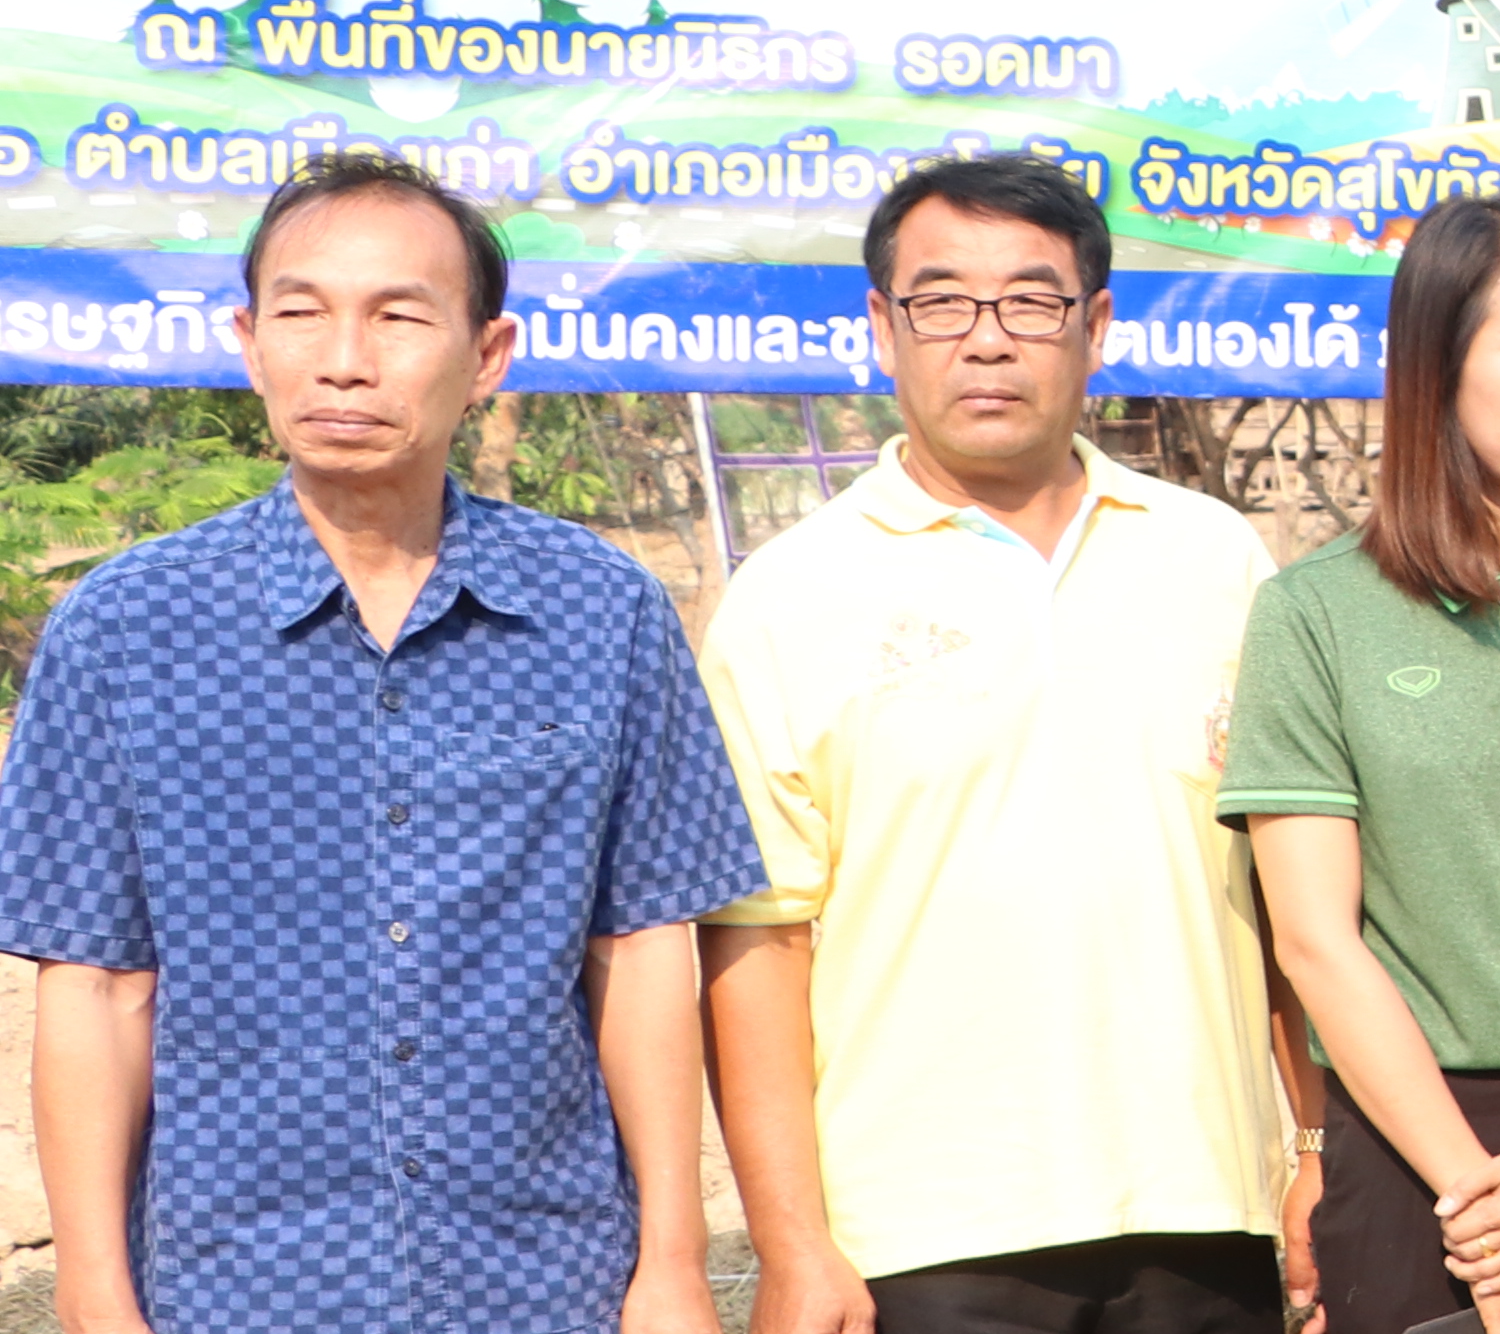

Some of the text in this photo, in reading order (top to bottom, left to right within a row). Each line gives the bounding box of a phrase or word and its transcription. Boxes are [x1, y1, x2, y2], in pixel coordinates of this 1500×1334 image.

[142, 13, 217, 62] ณ
[902, 40, 1111, 89] รอดมา
[1102, 303, 1361, 368] ตนเองได้
